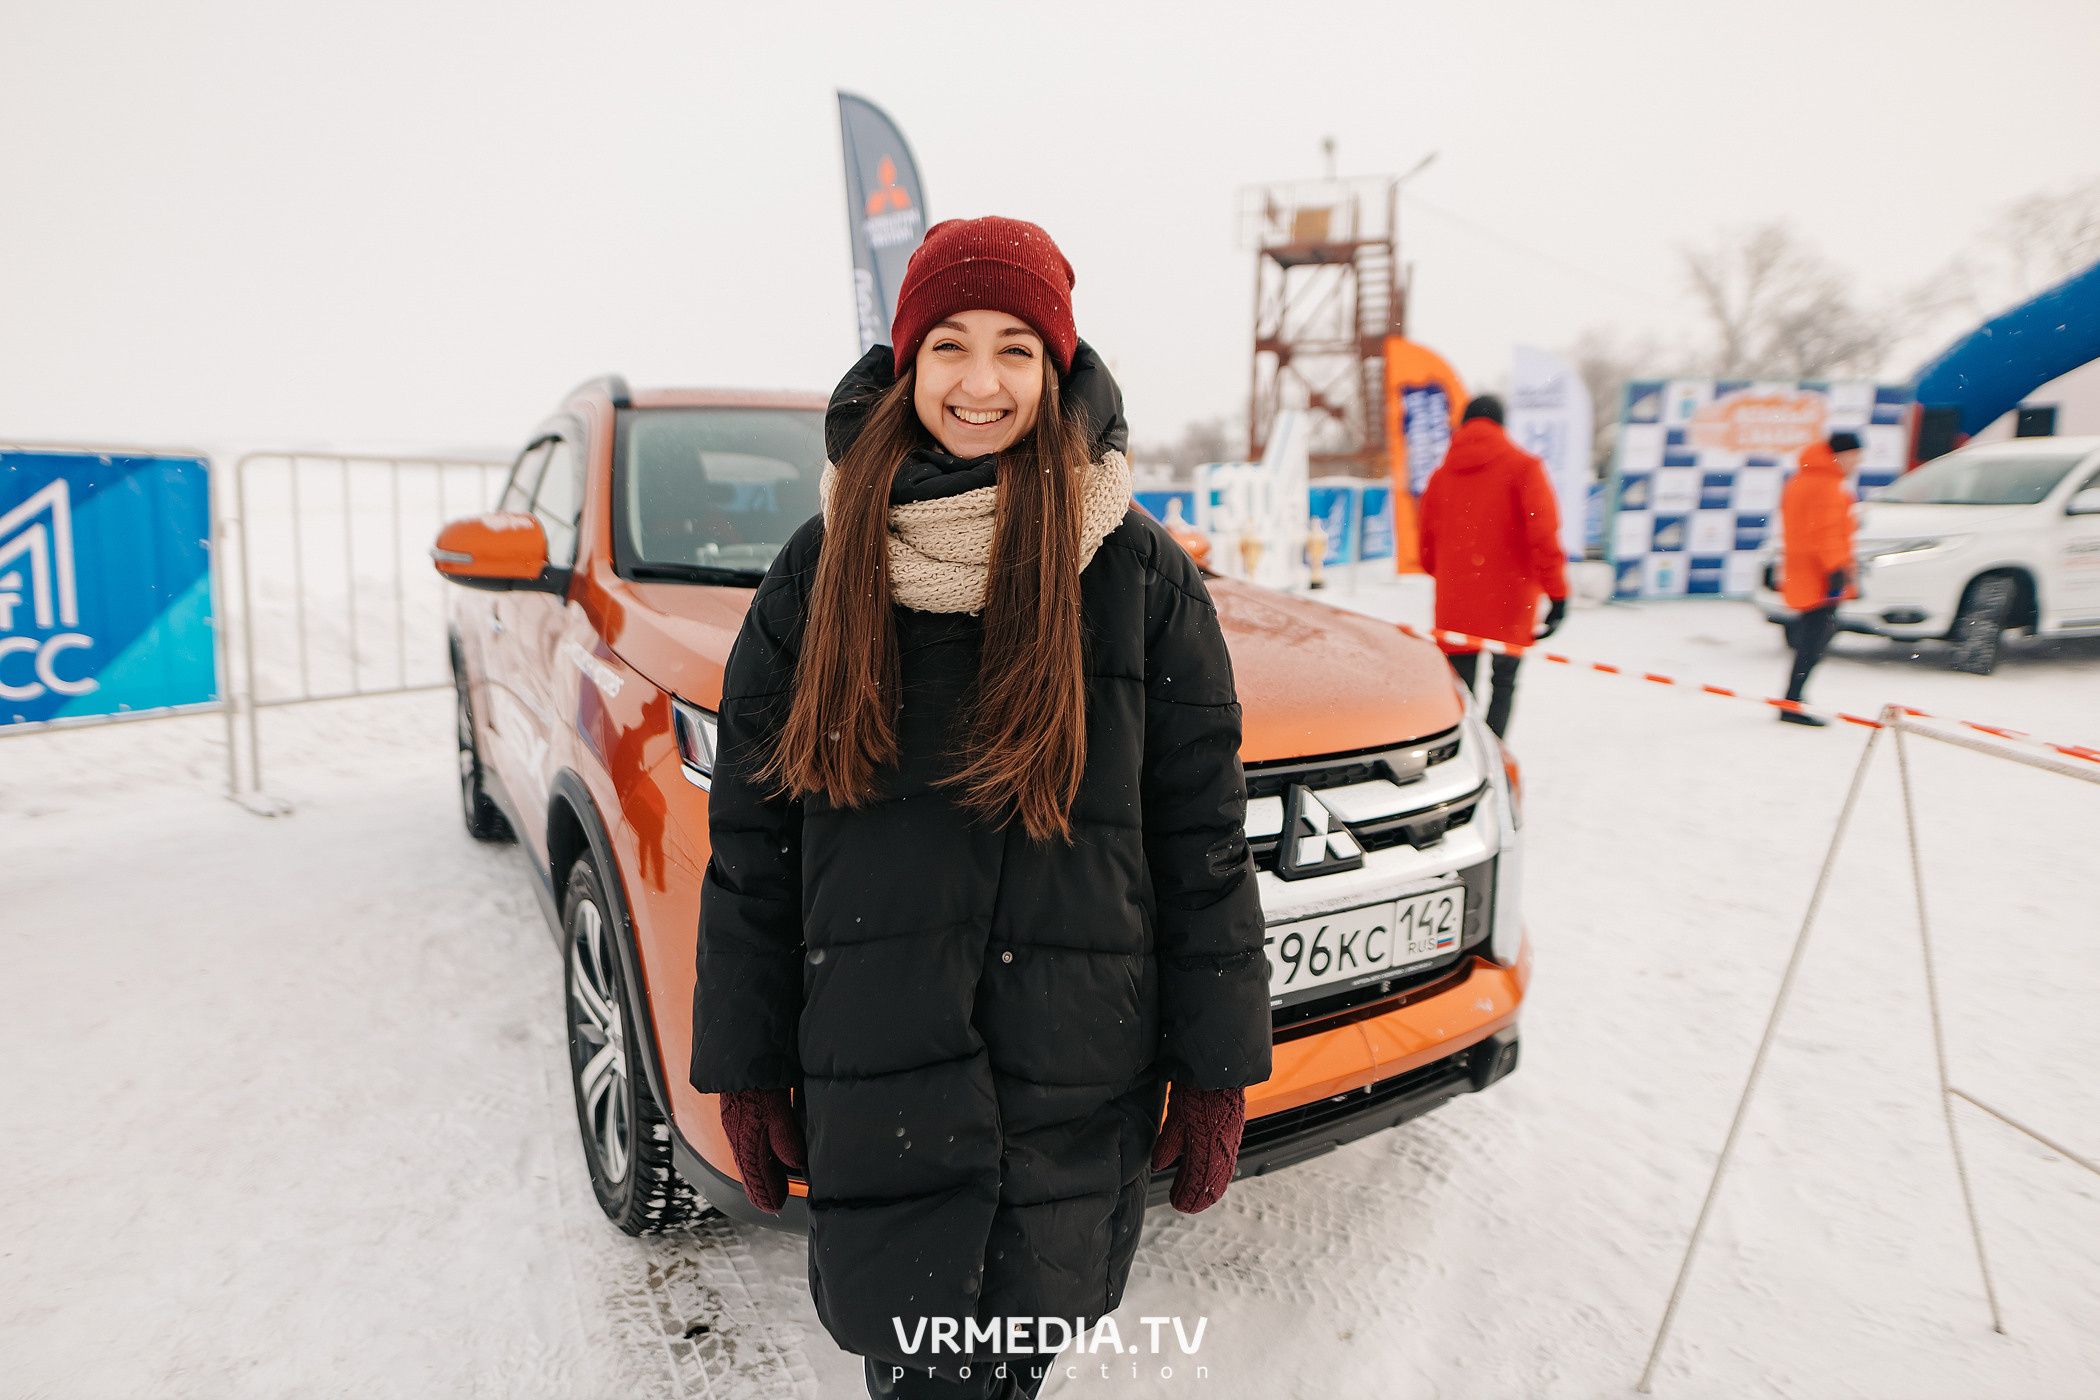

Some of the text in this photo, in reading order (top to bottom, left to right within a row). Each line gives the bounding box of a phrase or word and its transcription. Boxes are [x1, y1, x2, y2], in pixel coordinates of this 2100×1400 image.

[1400, 897, 1453, 941] 142
[1264, 925, 1388, 985] 96КС
[1408, 936, 1437, 955] RUS
